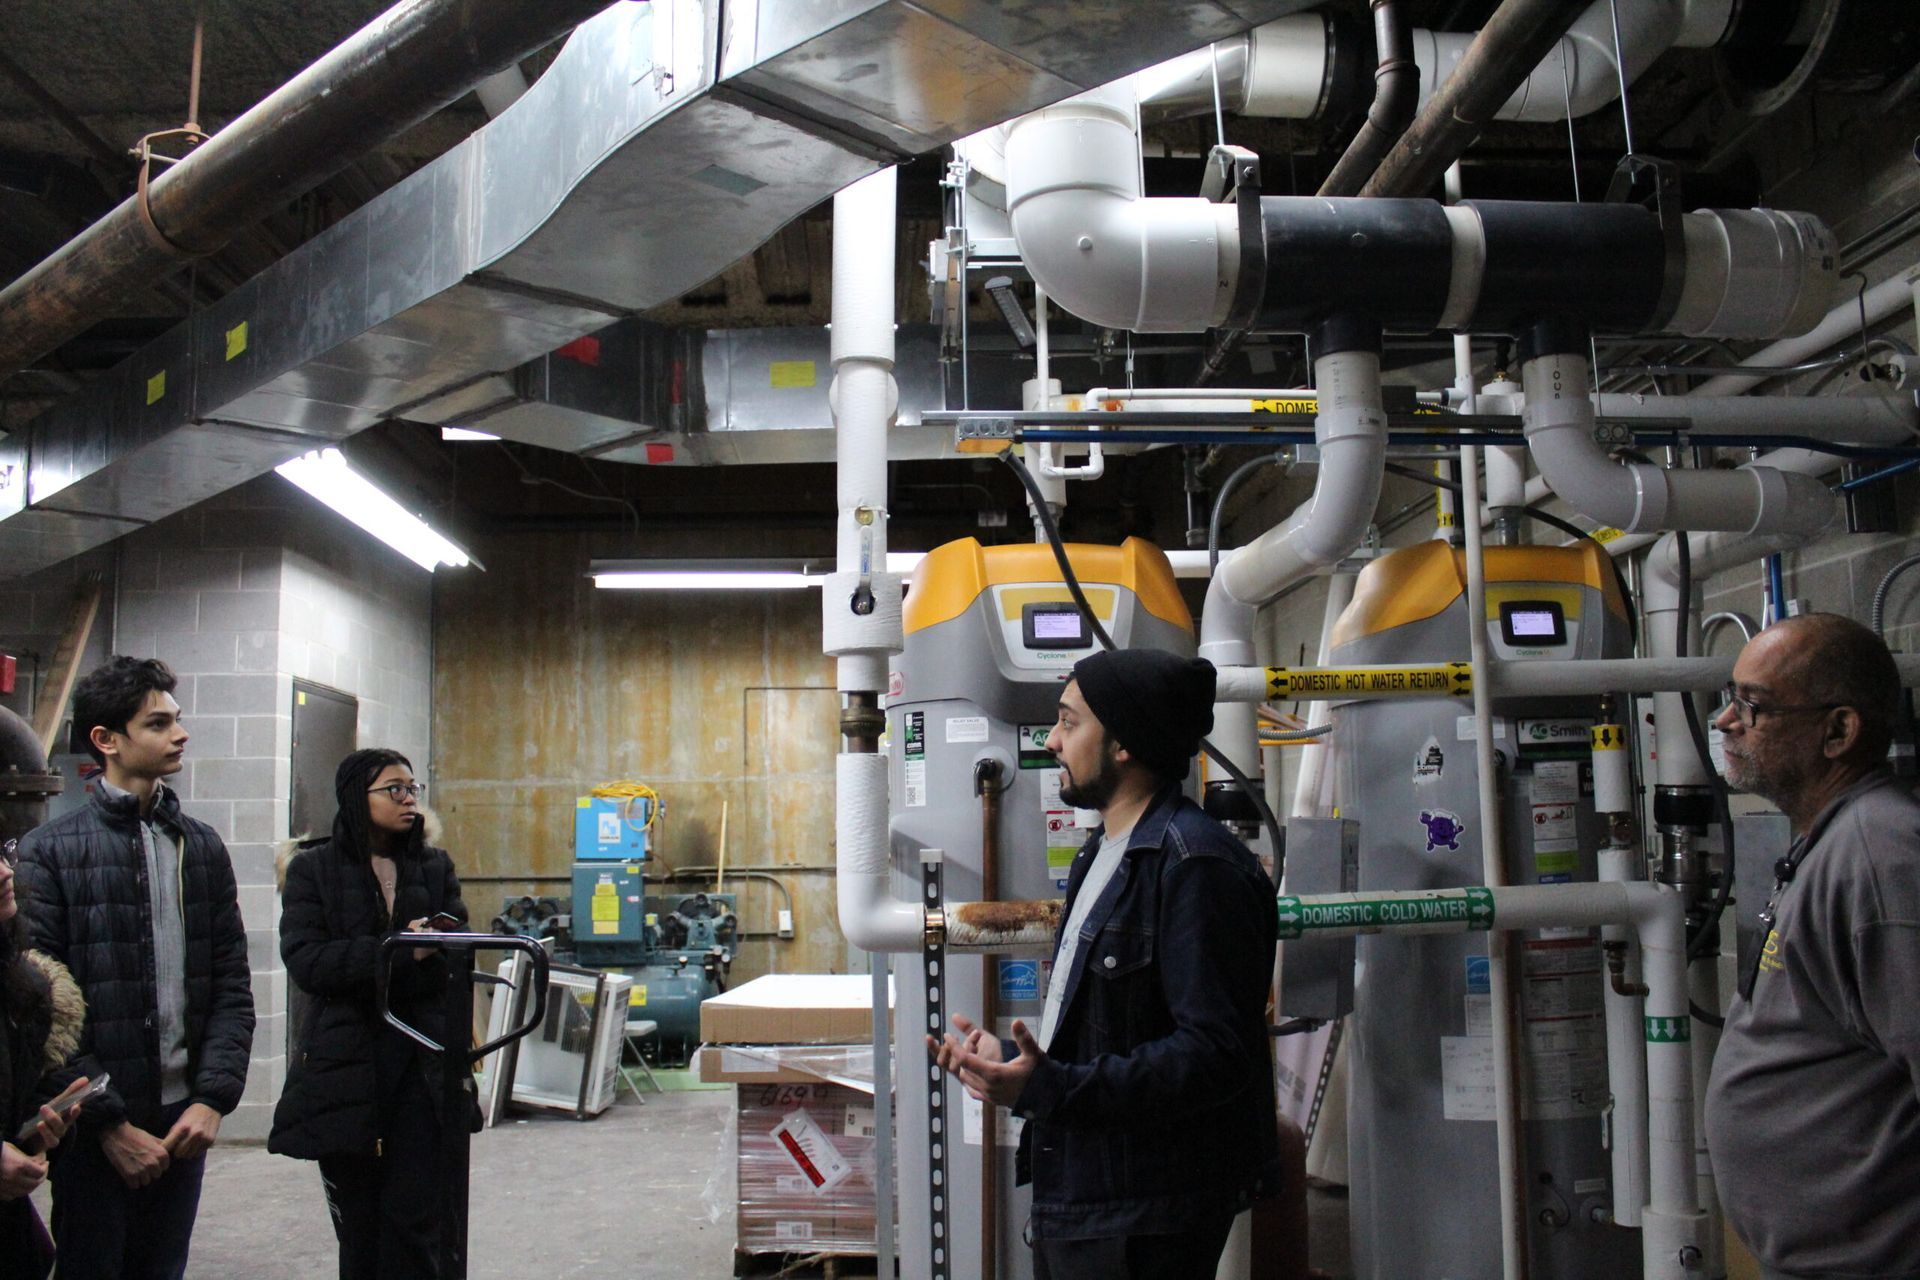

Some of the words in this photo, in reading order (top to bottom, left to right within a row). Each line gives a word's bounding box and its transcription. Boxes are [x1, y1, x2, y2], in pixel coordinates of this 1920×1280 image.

[1037, 652, 1067, 660] Cyclone
[1290, 674, 1340, 691] DOMESTIC
[1346, 673, 1365, 690] HOT
[1371, 673, 1404, 689] WATER
[1409, 672, 1449, 688] RETURN
[1550, 724, 1585, 738] Smith
[1302, 905, 1373, 925] DOMESTIC
[1380, 902, 1418, 923] COLD
[1419, 900, 1468, 919] WATER
